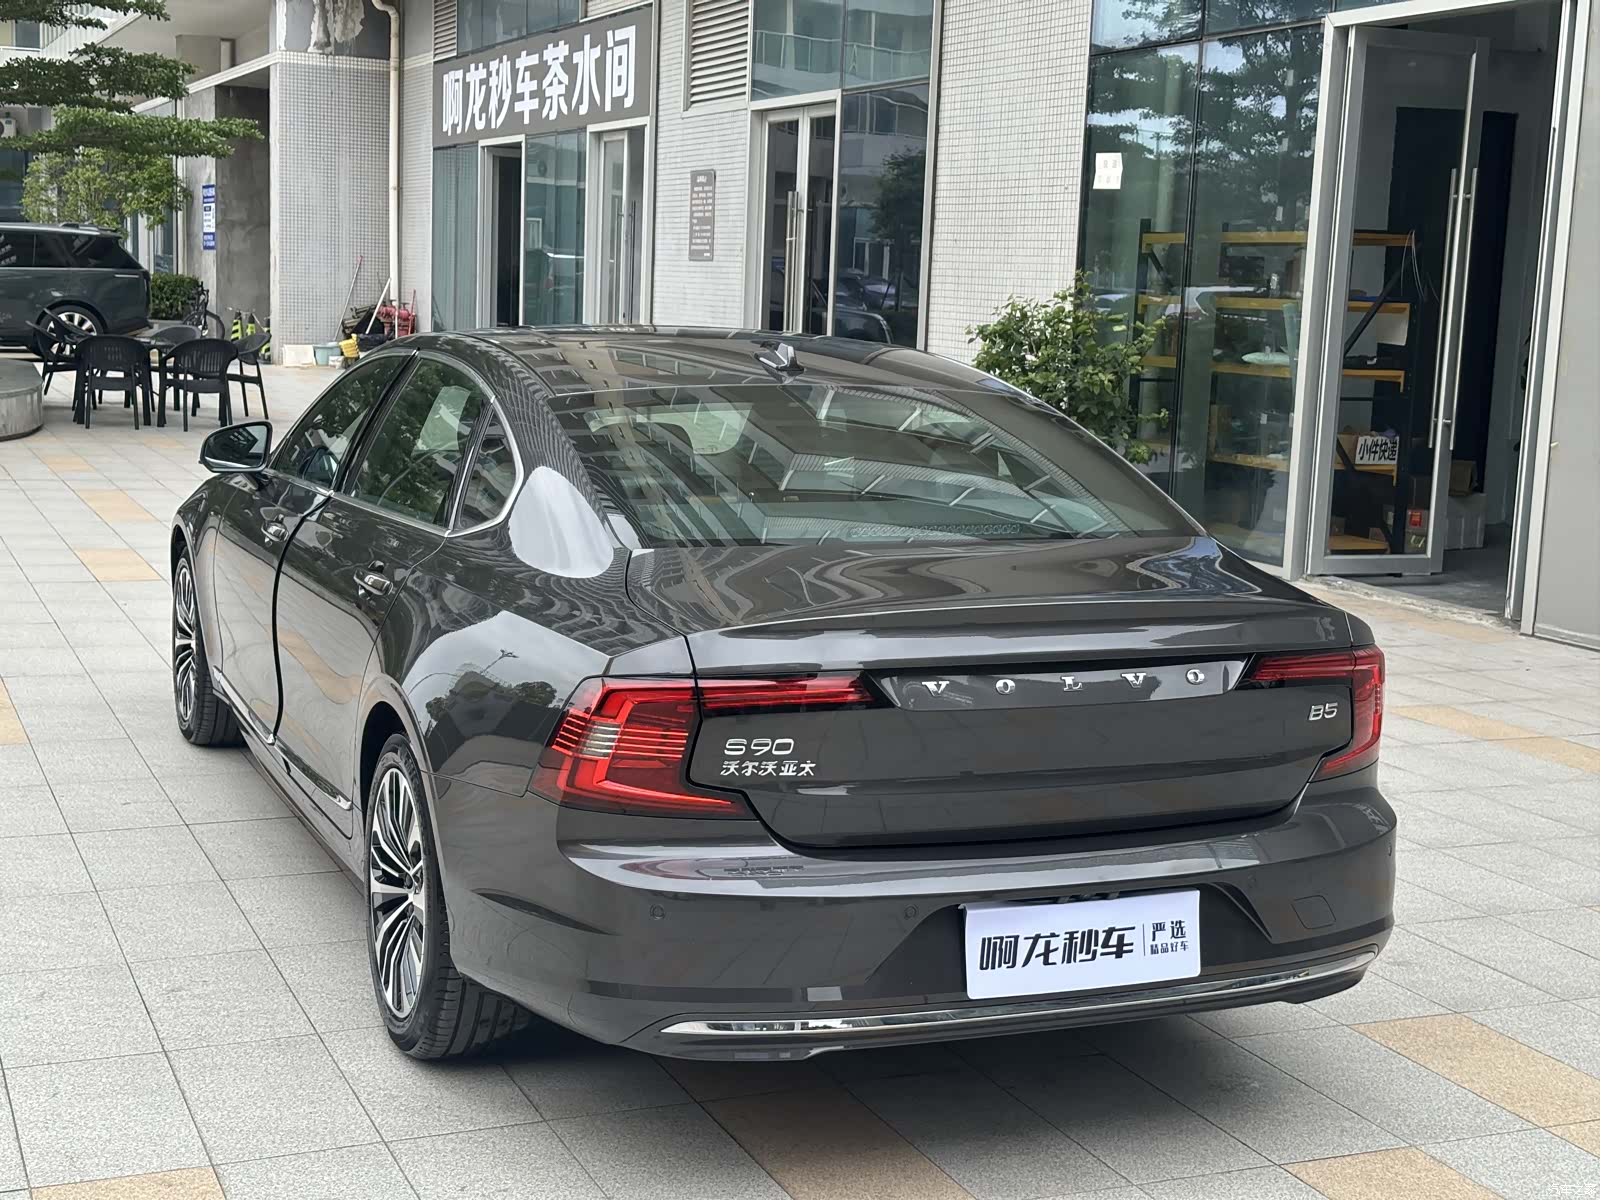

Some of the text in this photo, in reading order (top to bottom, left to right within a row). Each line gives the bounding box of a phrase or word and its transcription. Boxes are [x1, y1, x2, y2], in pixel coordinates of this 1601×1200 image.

[442, 25, 636, 136] 啊龙秒车茶水间
[921, 669, 1206, 697] VOLVO
[1308, 702, 1338, 721] B5
[724, 738, 795, 756] S90
[720, 760, 817, 777] 沃尔沃亚太
[1152, 919, 1187, 942] 严选
[979, 926, 1136, 971] 啊龙秒车
[1150, 940, 1190, 955] 精品好车
